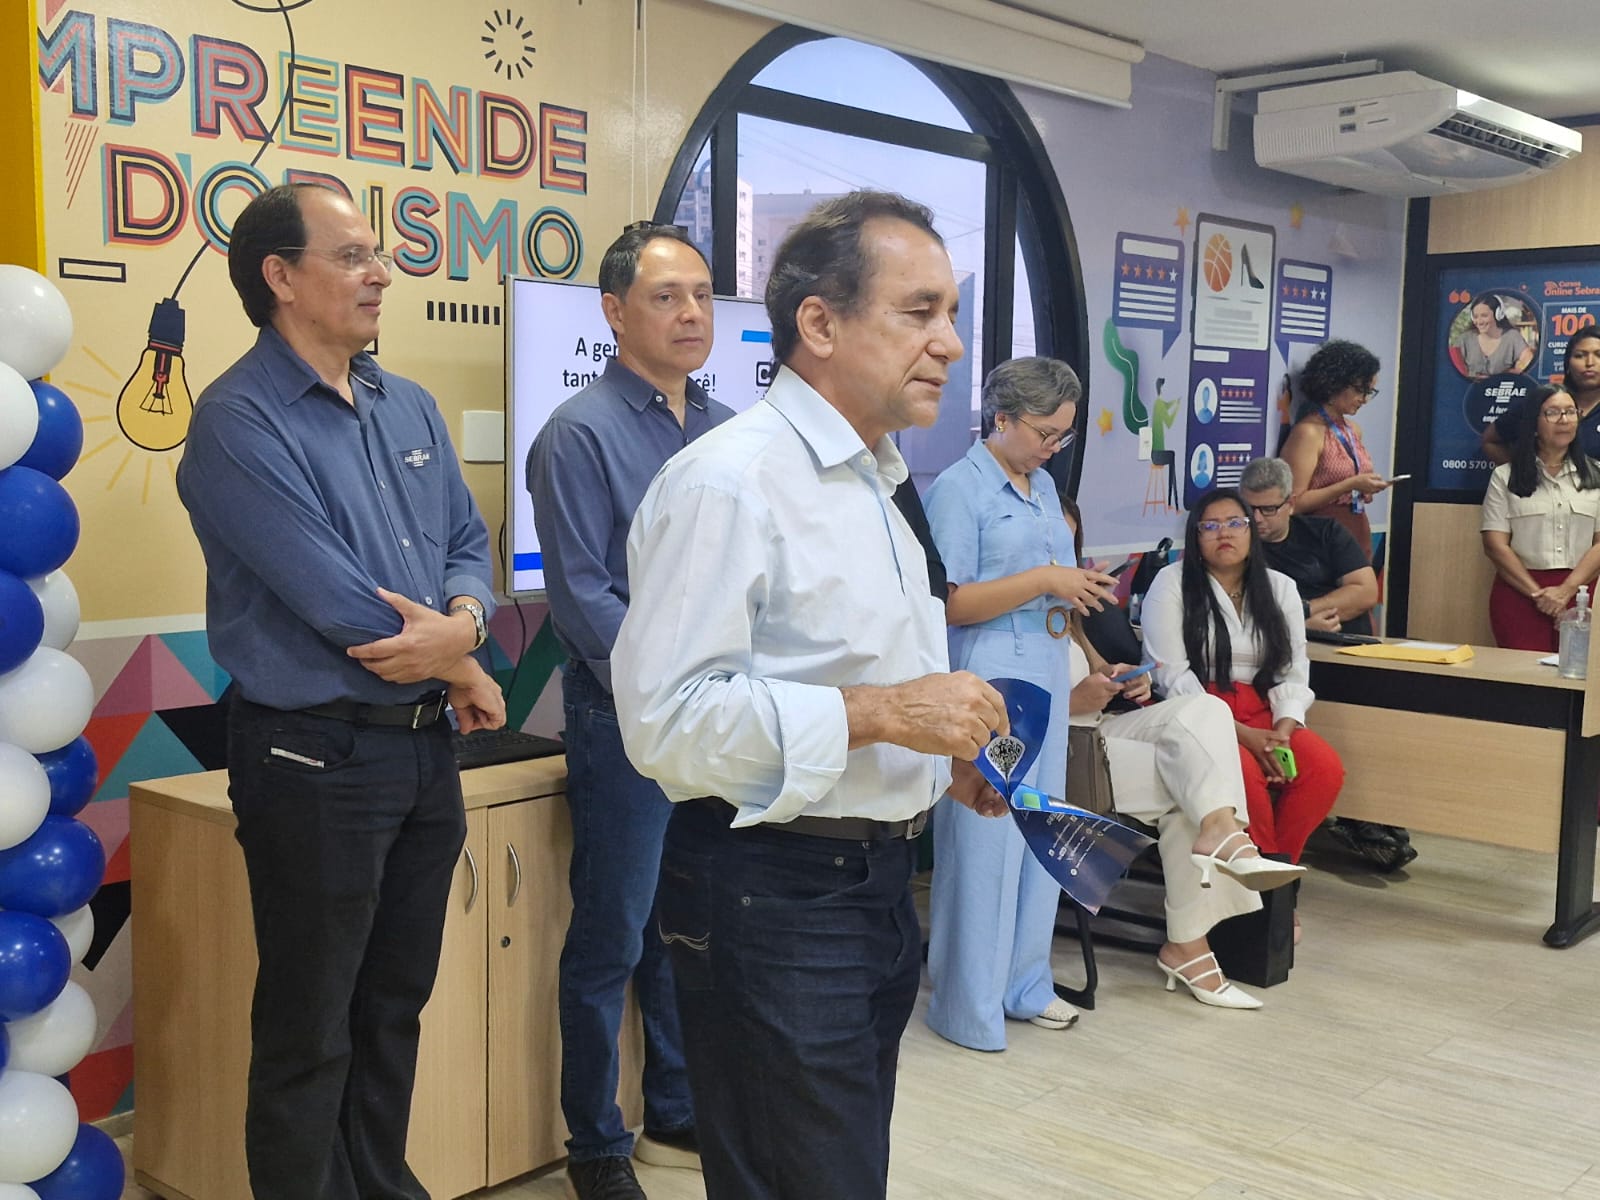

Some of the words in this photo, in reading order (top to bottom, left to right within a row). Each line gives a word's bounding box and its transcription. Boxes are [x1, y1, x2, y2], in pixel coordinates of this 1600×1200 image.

[1544, 287, 1573, 296] Online
[575, 337, 587, 356] A
[1484, 387, 1527, 397] SEBRAE
[1442, 459, 1467, 469] 0800
[1469, 460, 1487, 470] 570
